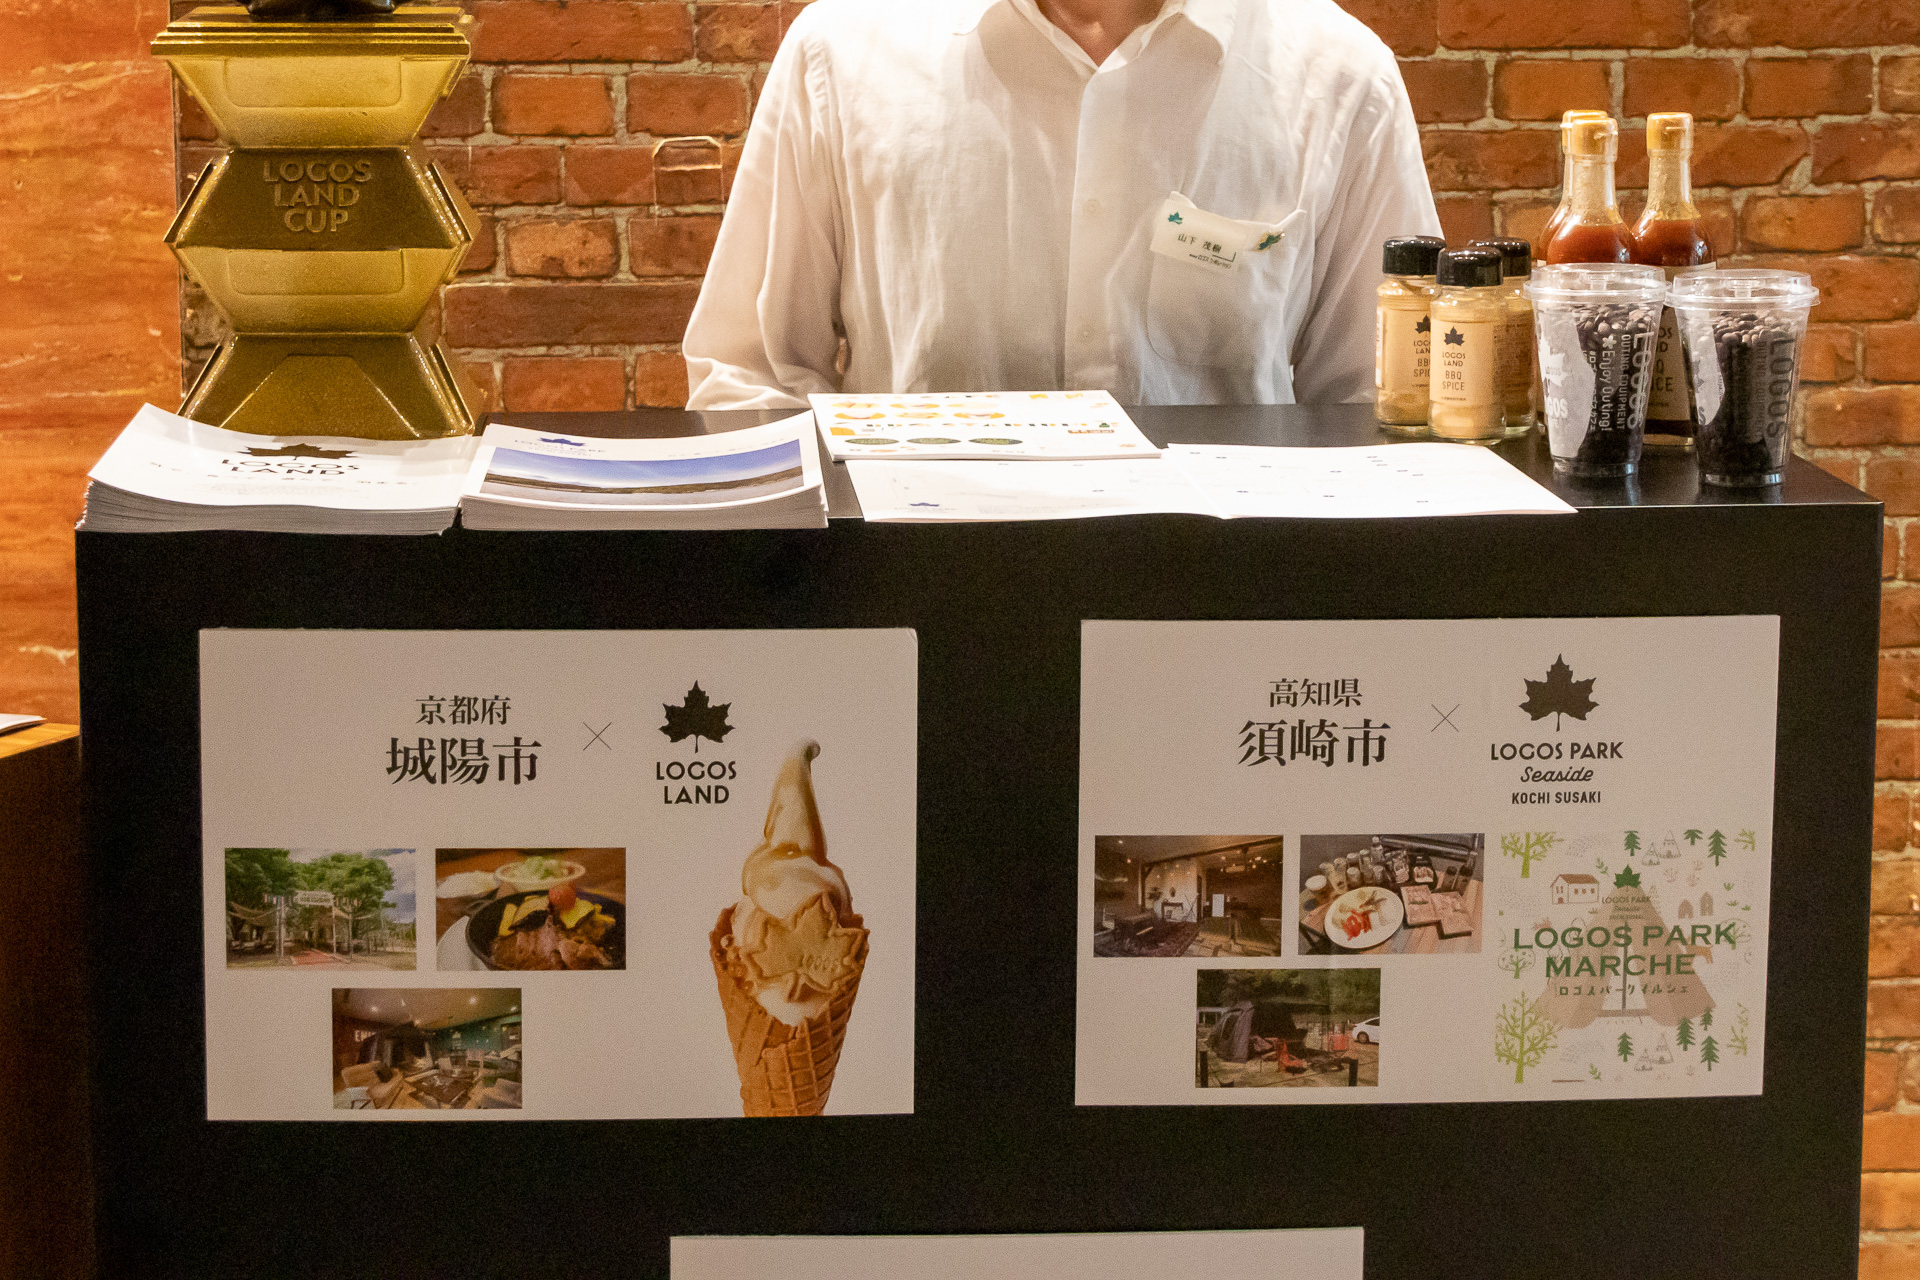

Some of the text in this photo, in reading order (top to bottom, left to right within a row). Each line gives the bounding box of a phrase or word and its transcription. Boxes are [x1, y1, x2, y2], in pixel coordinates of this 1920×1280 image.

[263, 160, 372, 182] LOGOS
[274, 183, 360, 207] LAND
[284, 209, 349, 233] CUP
[1418, 358, 1431, 368] BB
[1442, 351, 1466, 360] LOGOS
[1444, 360, 1464, 368] LAND
[1445, 370, 1462, 381] BBQ
[1442, 381, 1465, 392] SPICE
[1598, 350, 1616, 432] Enjoy Outing!
[1767, 338, 1796, 438] LOGOS
[1616, 373, 1629, 430] EQUIPMENT
[222, 459, 360, 471] LOGOS
[231, 466, 345, 475] LAND
[1269, 677, 1363, 708] 高知県
[415, 694, 511, 726] 京都府
[1237, 718, 1392, 768] 須崎市
[1491, 741, 1624, 761] LOGOS PARK
[385, 736, 542, 785] 城陽市
[656, 760, 737, 781] LOGOS
[1520, 766, 1594, 783] Seaside
[664, 785, 730, 805] LAND
[1511, 790, 1601, 805] KOCHI SUSAKI
[1513, 922, 1736, 949] LOGOS PARK
[1545, 953, 1697, 978] MARCHE
